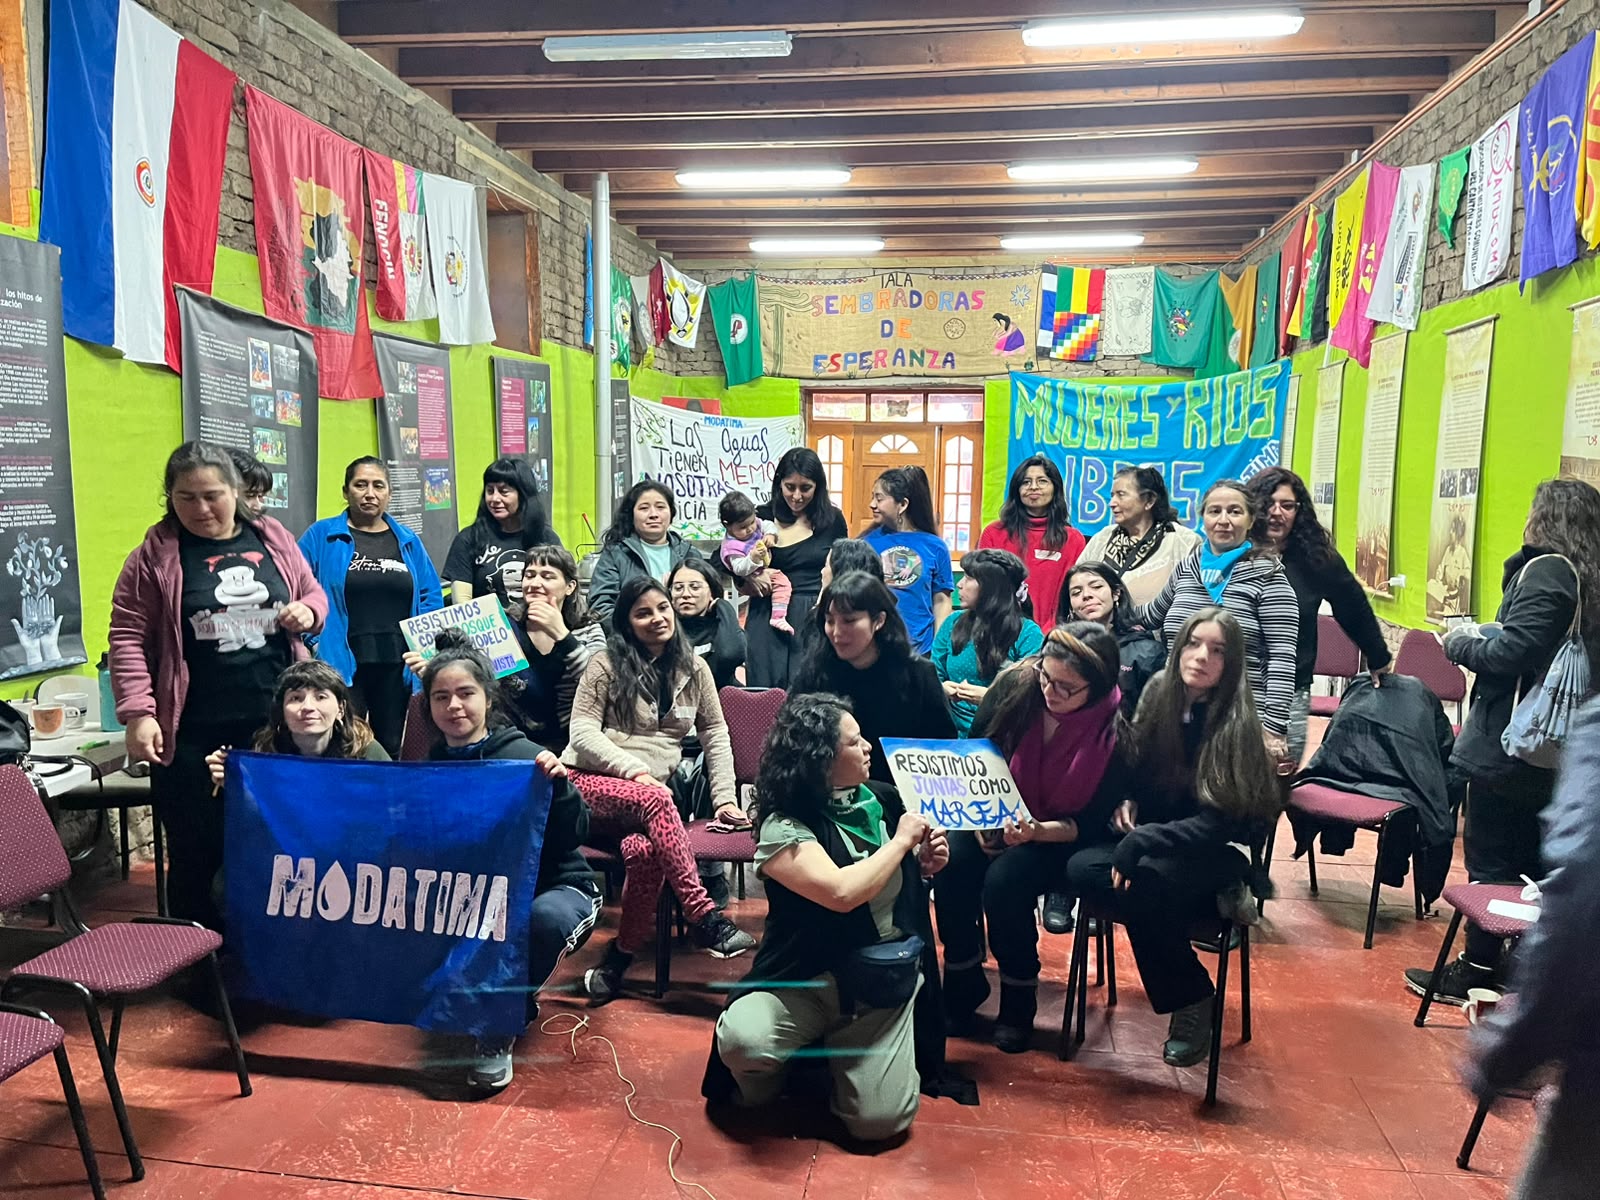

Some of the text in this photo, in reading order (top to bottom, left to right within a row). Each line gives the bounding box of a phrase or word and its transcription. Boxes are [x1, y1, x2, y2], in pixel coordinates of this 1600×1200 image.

[374, 198, 396, 280] FENOCIN
[0, 298, 23, 310] zación
[811, 289, 986, 317] SEMBRADORAS
[880, 318, 913, 339] DE
[812, 347, 957, 376] ESPERANZA
[1014, 379, 1161, 451] MUJERES
[1183, 362, 1283, 449] RIOS
[704, 415, 743, 429] MODATIMA
[718, 457, 779, 486] MEMO
[407, 601, 481, 636] RESISTIMOS
[458, 613, 497, 636] OSQUE
[492, 655, 517, 672] VISTA
[894, 753, 988, 777] RESISTIMOS
[912, 775, 1011, 797] JUNTAS COMO
[919, 797, 1021, 828] MAREA
[266, 854, 509, 942] MODATIMA
